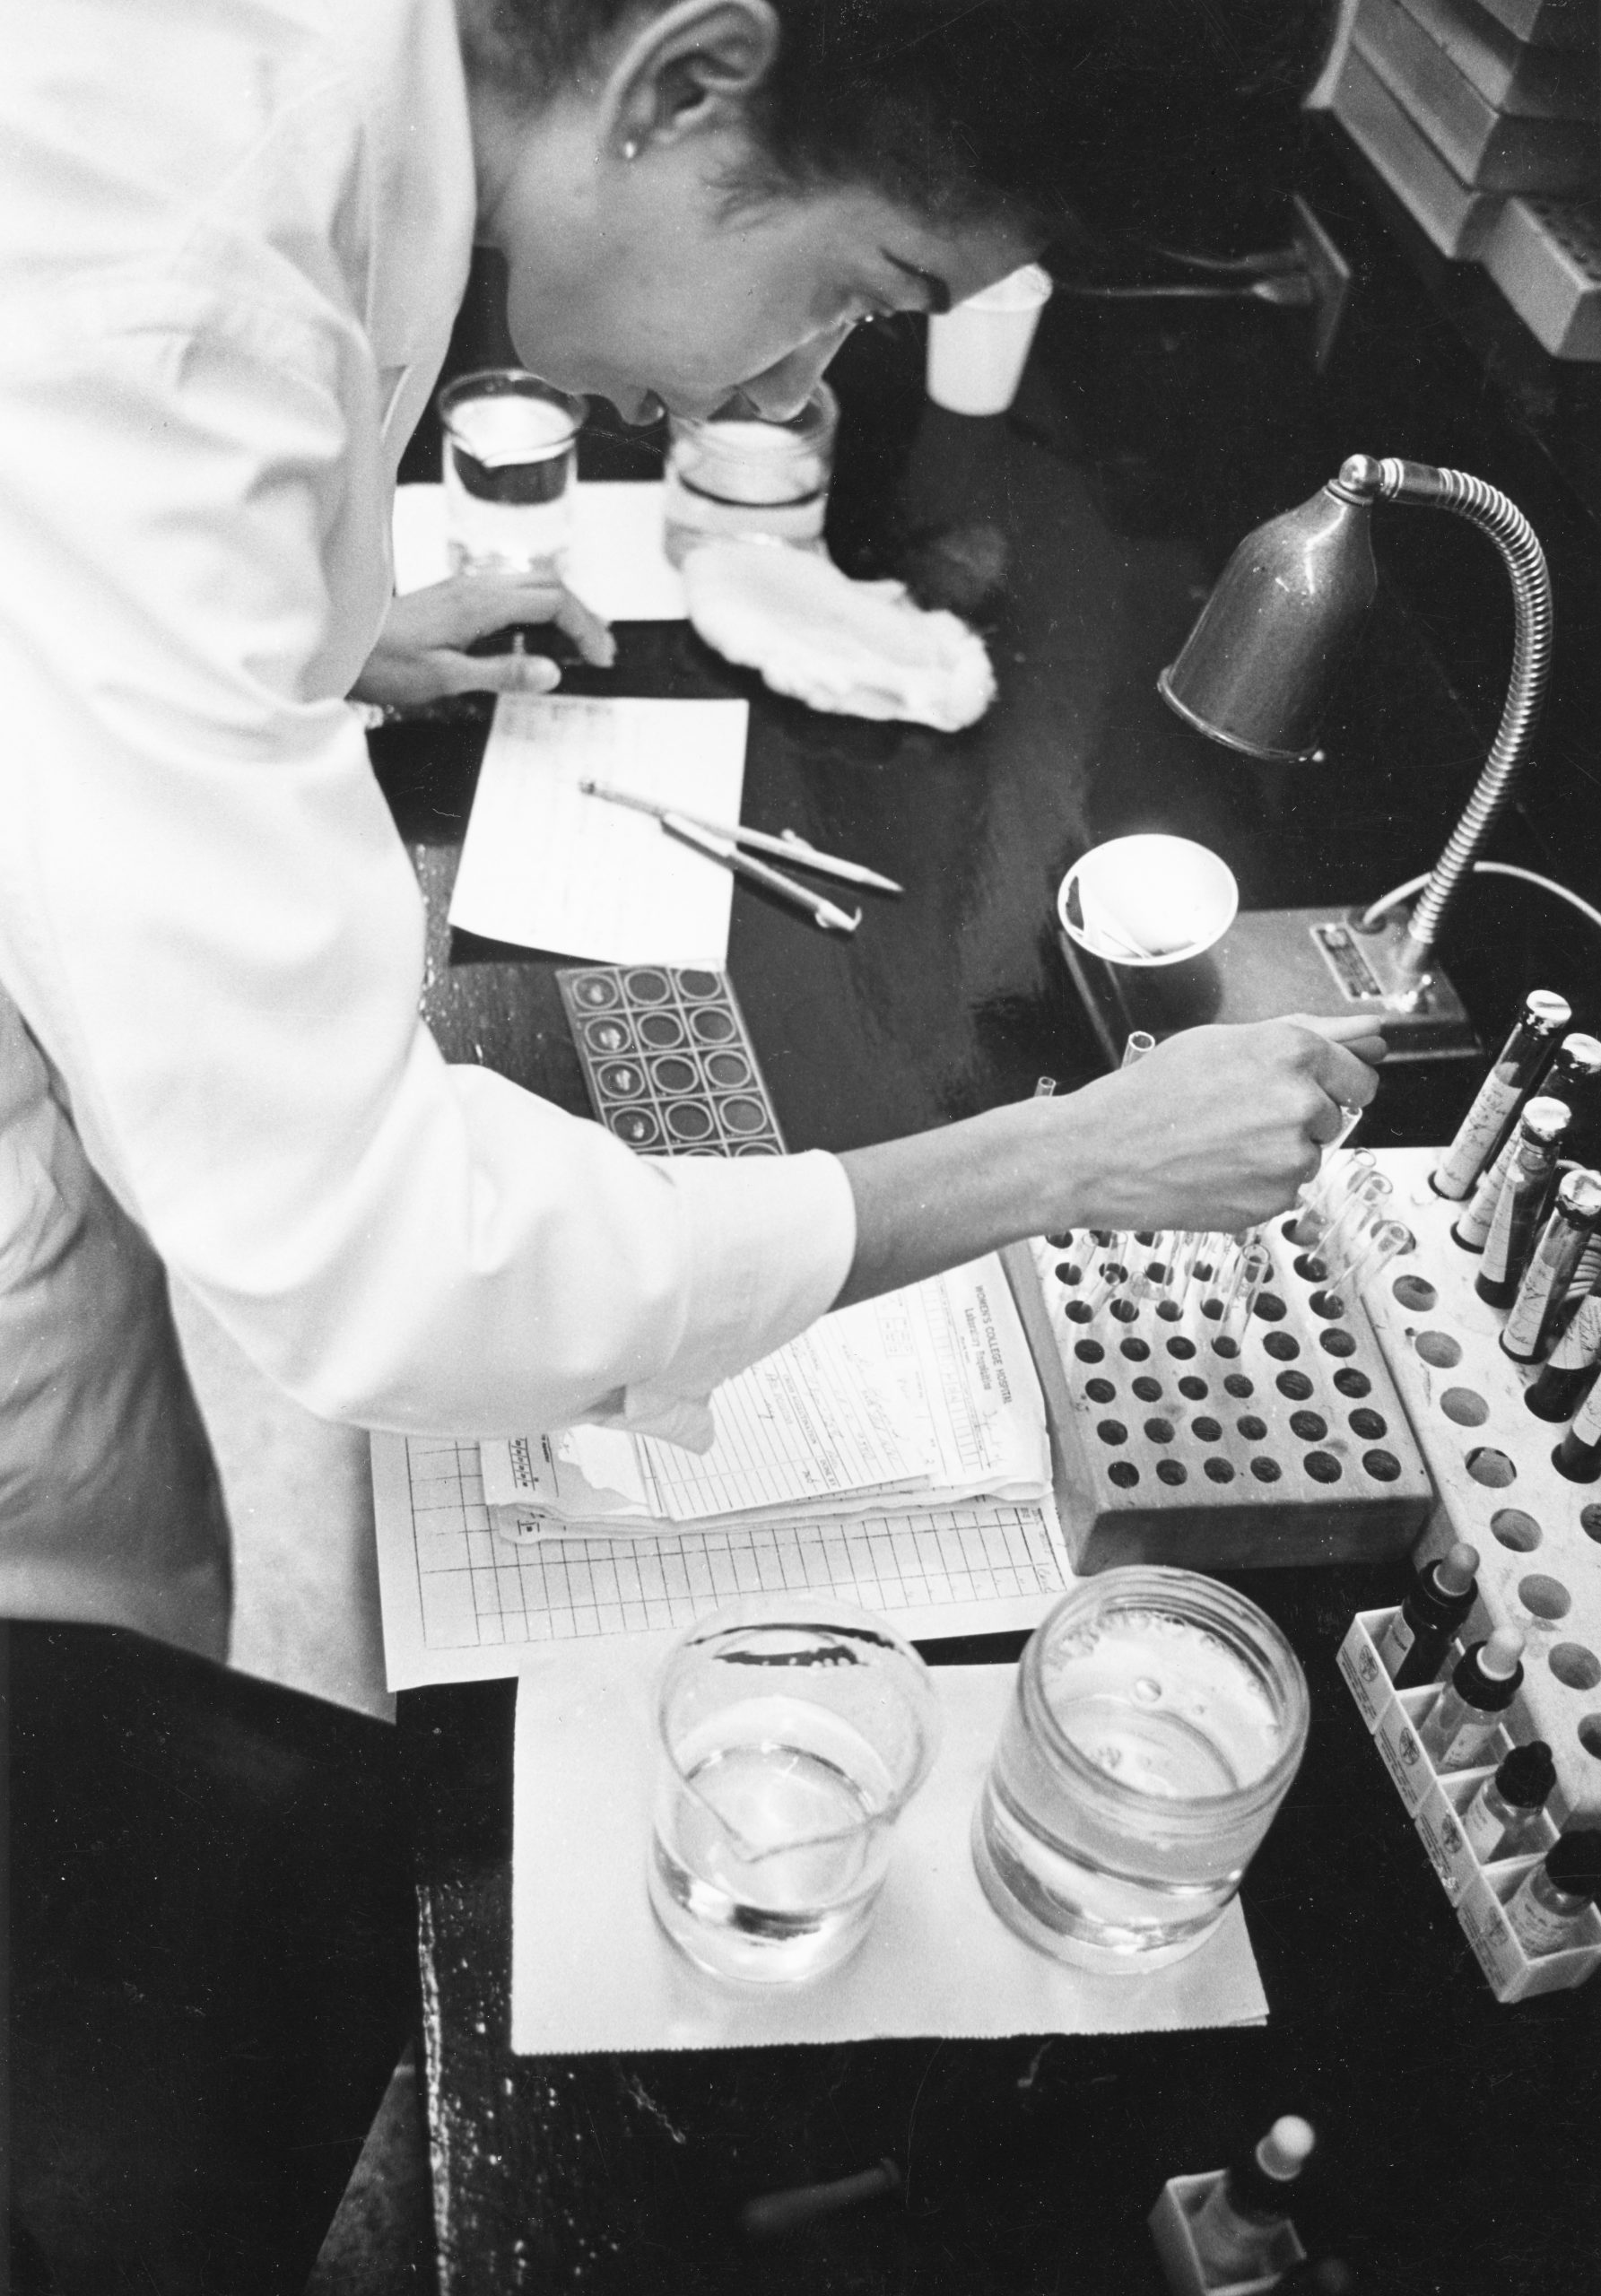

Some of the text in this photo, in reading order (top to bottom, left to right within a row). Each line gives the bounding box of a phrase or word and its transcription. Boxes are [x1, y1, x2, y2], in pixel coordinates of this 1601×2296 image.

[974, 1284, 1013, 1405] WOMEN'S COLLEGE HOSPITAL
